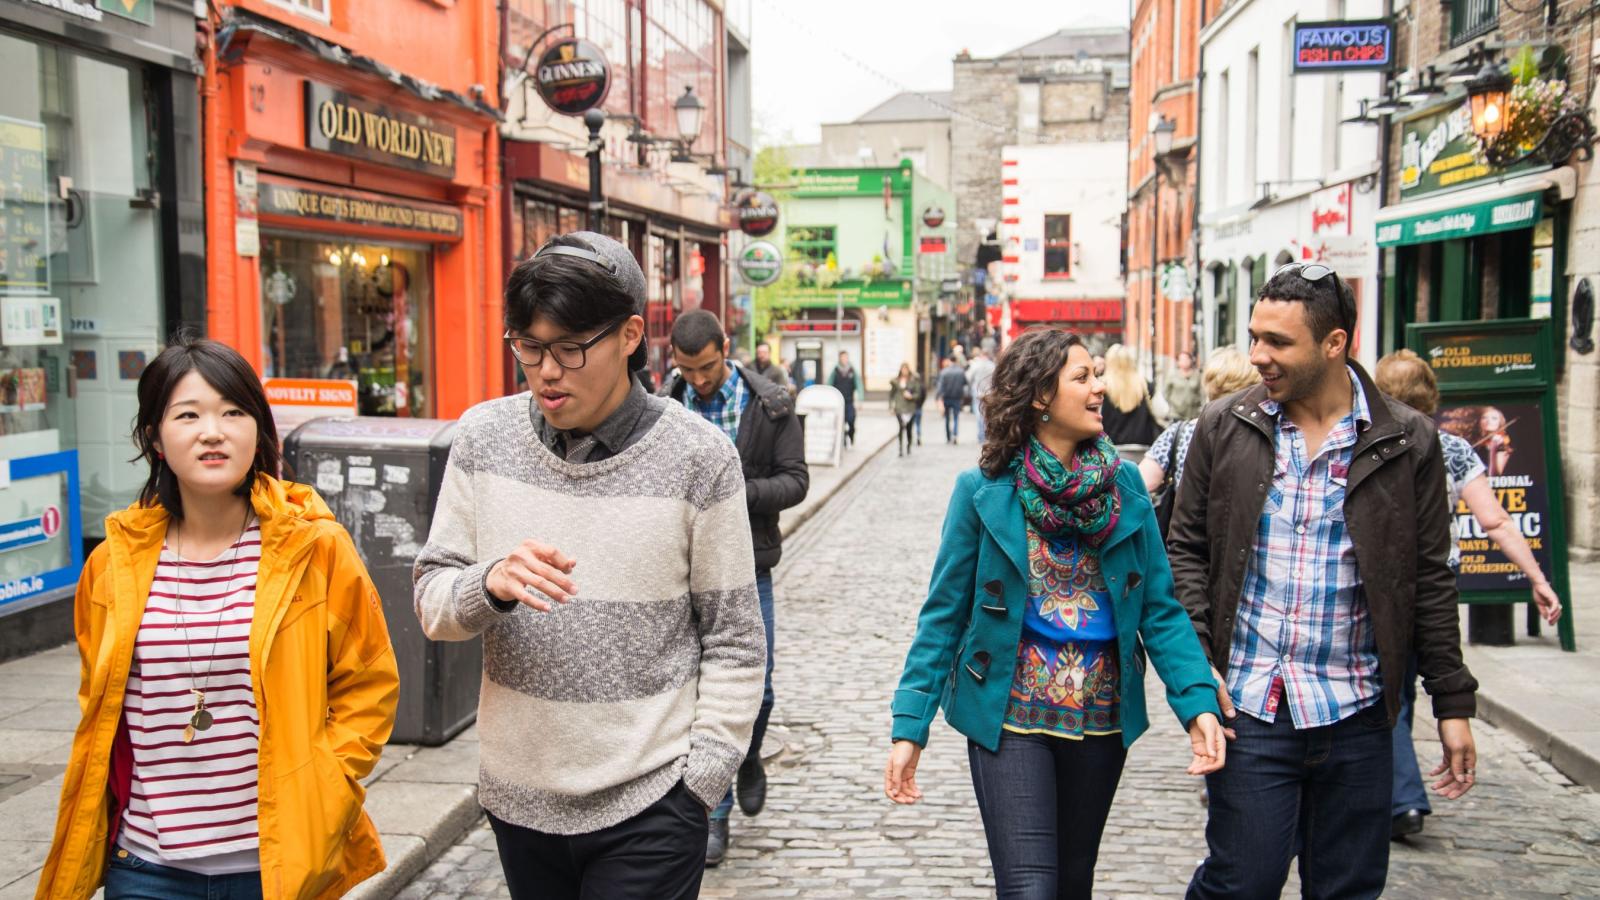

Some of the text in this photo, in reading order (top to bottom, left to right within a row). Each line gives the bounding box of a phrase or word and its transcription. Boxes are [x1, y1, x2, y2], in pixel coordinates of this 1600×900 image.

[1300, 28, 1383, 47] FAMOUS
[1299, 47, 1329, 62] FISH
[1344, 44, 1384, 60] CHIPS
[321, 101, 455, 167] OLD WORLD NEW
[274, 189, 319, 215] UNIQUE
[320, 196, 348, 217] GIFTS
[350, 200, 377, 221] FROM
[1444, 346, 1470, 357] OLD
[1432, 353, 1532, 368] STOREHOUSE
[267, 387, 316, 401] NOVELTY
[1487, 475, 1534, 488] TIONAL
[1456, 488, 1527, 513] LVE
[1455, 512, 1542, 538] MUIC
[1459, 539, 1488, 551] DAYS
[1460, 562, 1520, 574] TOREHO
